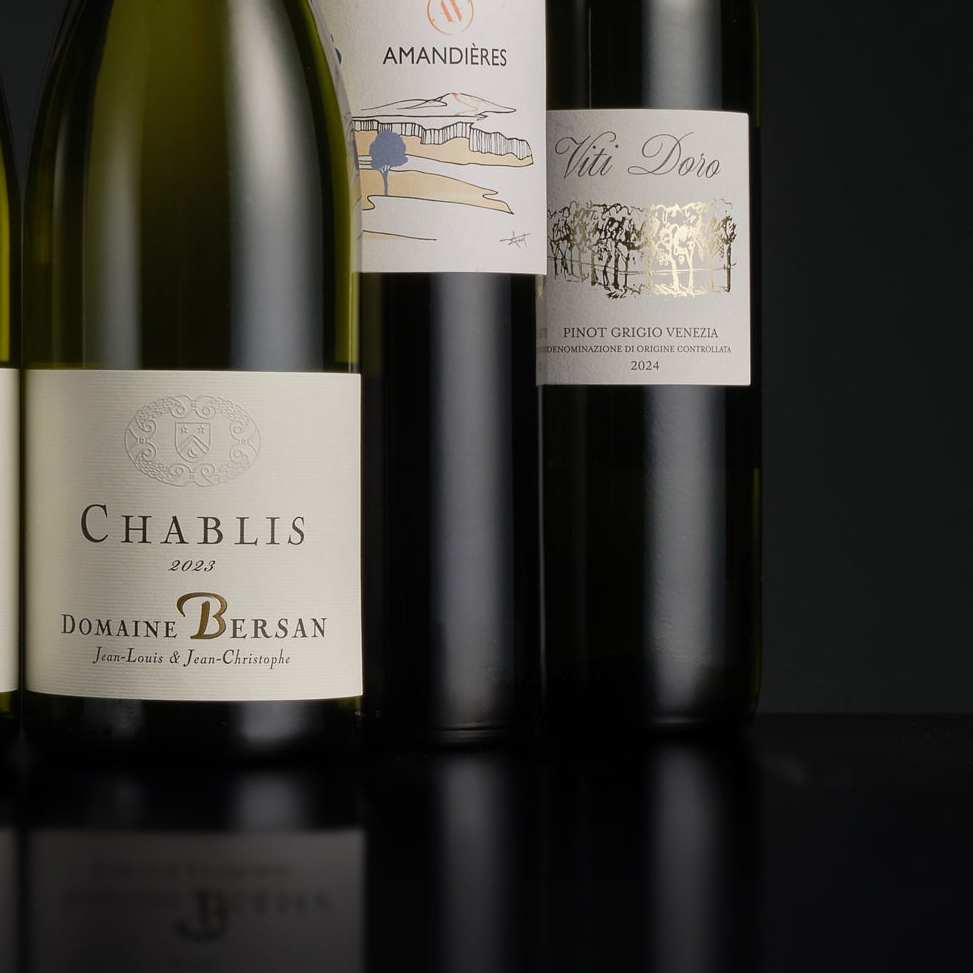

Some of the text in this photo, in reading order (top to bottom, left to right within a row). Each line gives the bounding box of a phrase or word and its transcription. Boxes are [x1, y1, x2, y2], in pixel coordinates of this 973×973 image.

[383, 43, 507, 66] AMANDIÈRES
[554, 131, 720, 179] Viti Doro
[563, 327, 718, 338] PINOT GRIGIO VENEZIA
[547, 344, 731, 354] DENOMINAZIONE DI ORIGINE CONTROLLATA
[631, 360, 659, 370] 2024
[167, 559, 216, 572] 2023
[92, 644, 290, 669] Jean-Louis & Jean-Christophe
